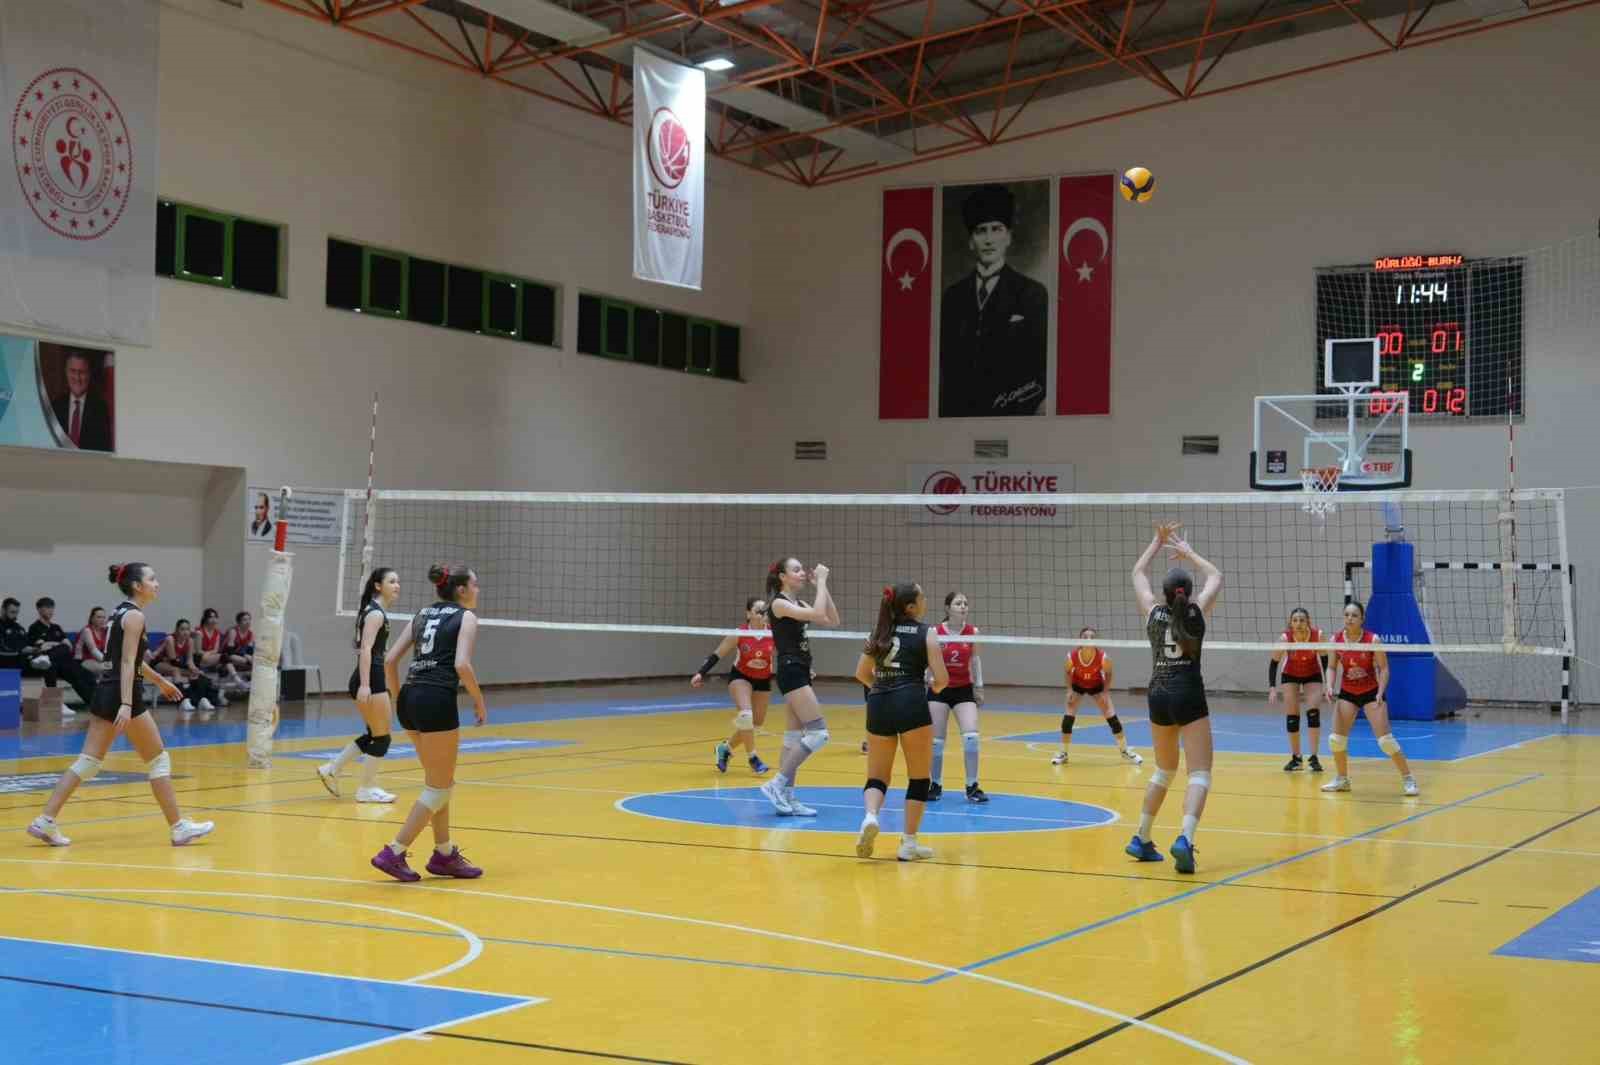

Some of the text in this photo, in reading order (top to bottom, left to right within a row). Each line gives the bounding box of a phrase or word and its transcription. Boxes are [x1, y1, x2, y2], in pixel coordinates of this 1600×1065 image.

[647, 190, 690, 216] TÜRKİYE
[1396, 282, 1448, 305] 11:44
[1412, 363, 1424, 381] 2
[1423, 388, 1466, 413] 012
[970, 470, 1058, 492] TÜRKİYE
[970, 504, 1057, 517] FEDERASYONU
[421, 619, 440, 654] 5
[882, 636, 901, 668] 2
[951, 650, 960, 661] 2
